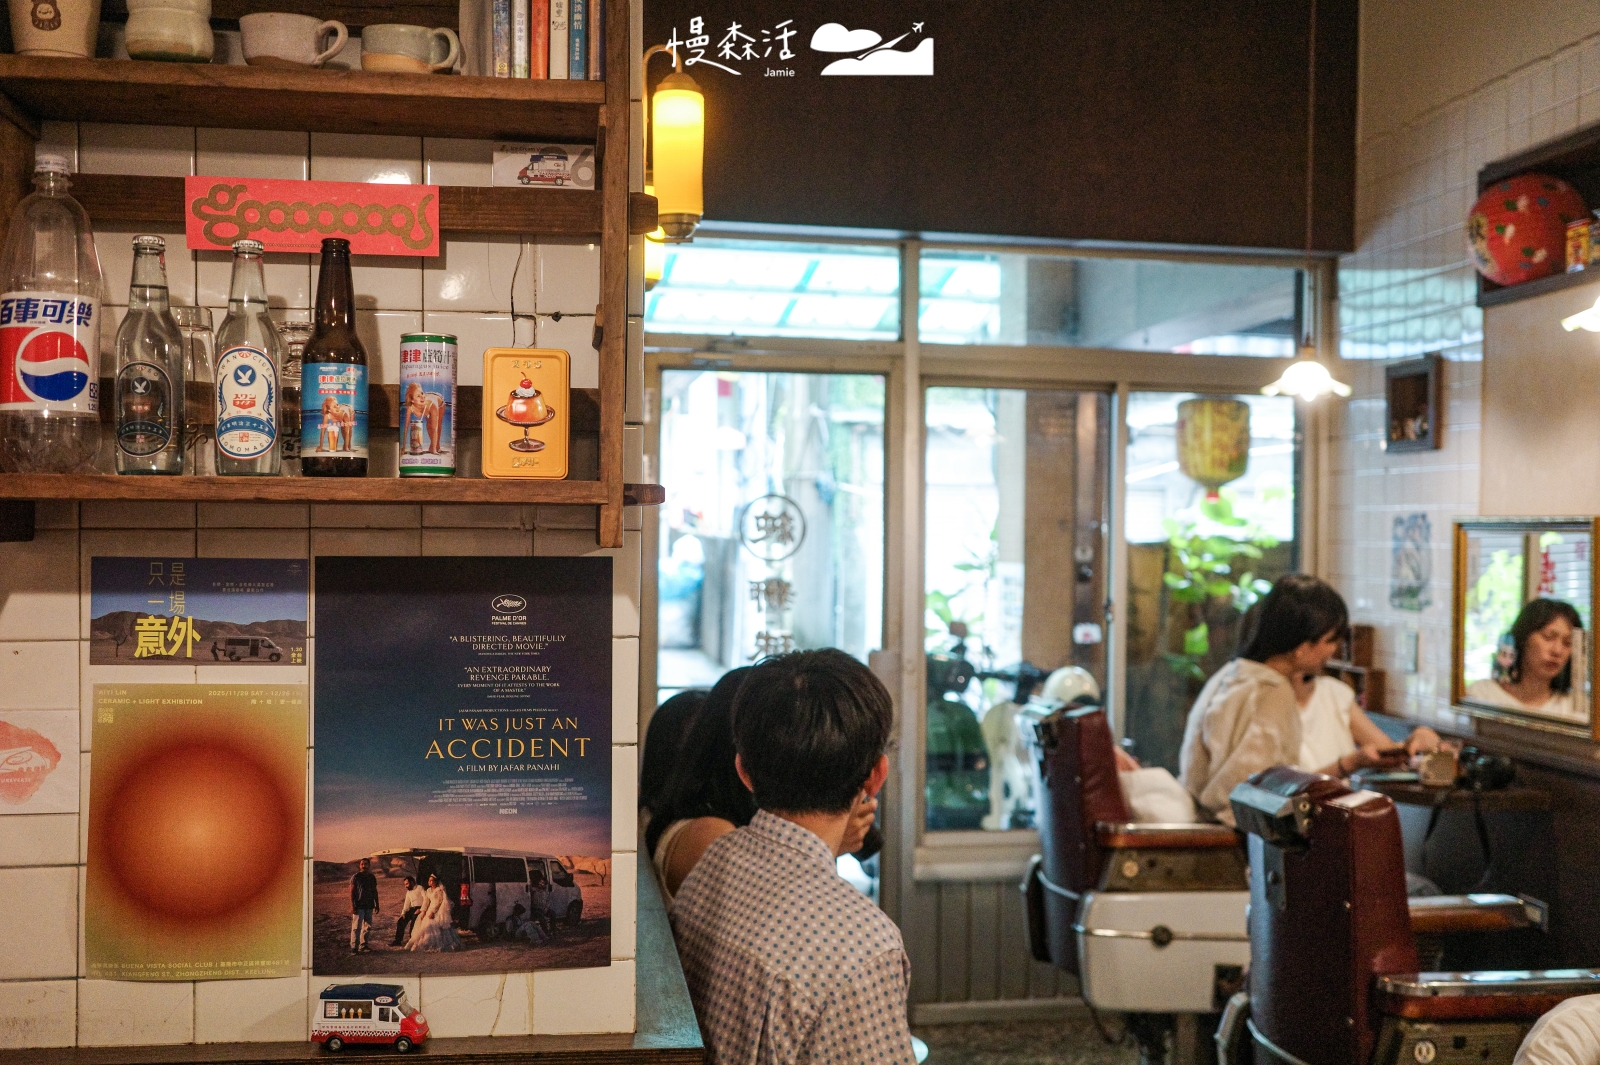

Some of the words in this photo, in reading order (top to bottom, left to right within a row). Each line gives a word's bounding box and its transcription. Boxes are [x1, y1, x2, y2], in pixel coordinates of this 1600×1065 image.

[0, 297, 93, 327] 百事可樂
[218, 355, 237, 377] SWAN
[252, 355, 273, 378] CIDER
[220, 437, 270, 452] TOMOMASU
[148, 562, 186, 586] 只是
[147, 590, 185, 615] 一場
[134, 615, 201, 658] 意外
[460, 635, 510, 643] BLISTERING,
[515, 642, 549, 650] MOVIE."
[481, 665, 551, 673] EXTRAORDINARY
[511, 673, 550, 681] PARABLE.
[439, 718, 455, 731] IT
[461, 717, 499, 731] WAS
[504, 717, 546, 733] JUST
[551, 717, 578, 730] AN
[424, 737, 591, 759] ACCIDENT
[466, 764, 486, 772] FILM
[499, 764, 524, 773] JAFAR
[526, 763, 560, 771] PANAHI
